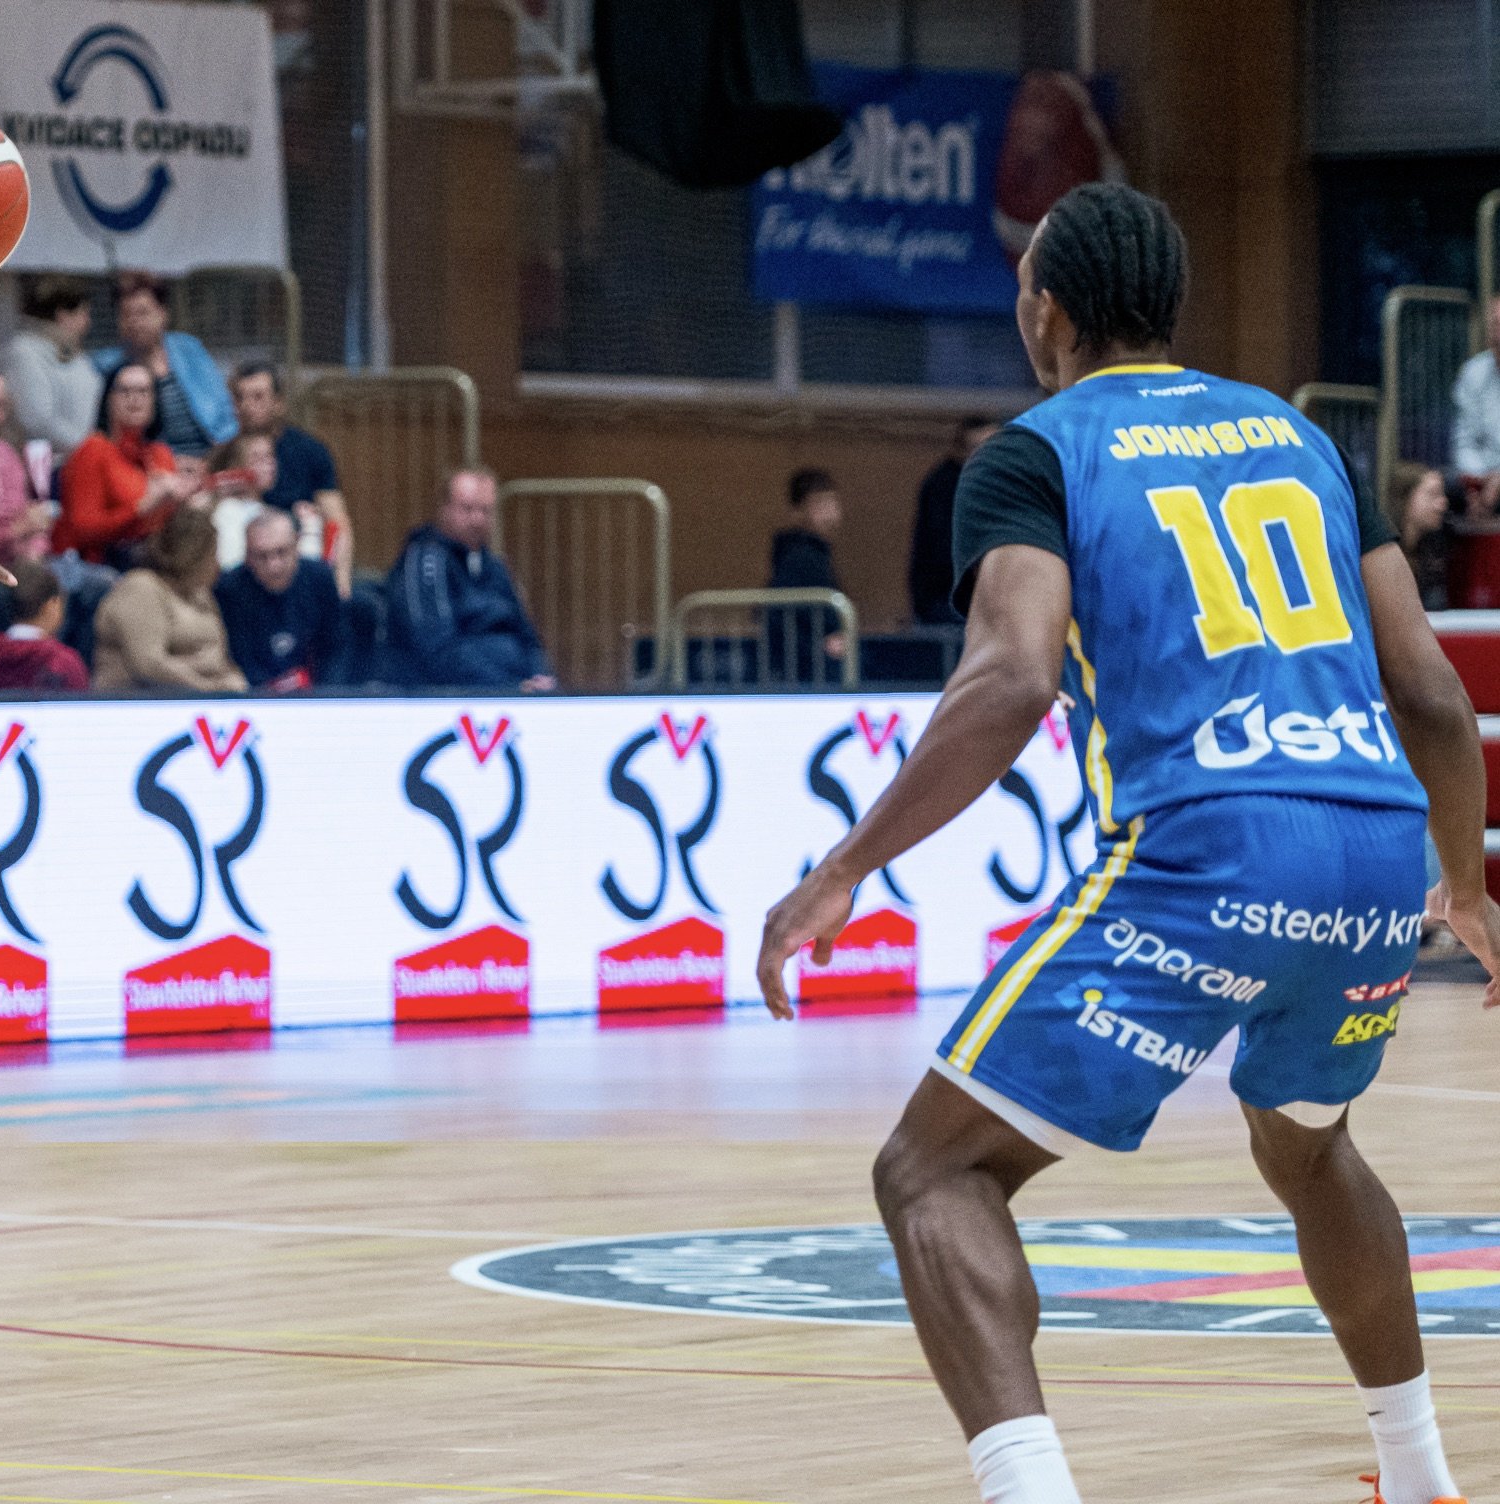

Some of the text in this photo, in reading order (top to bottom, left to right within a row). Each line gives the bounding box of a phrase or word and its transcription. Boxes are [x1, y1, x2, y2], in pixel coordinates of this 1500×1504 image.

[1108, 415, 1304, 460] JOHNSON
[1144, 476, 1354, 661] 10
[1102, 917, 1267, 1004] aperam
